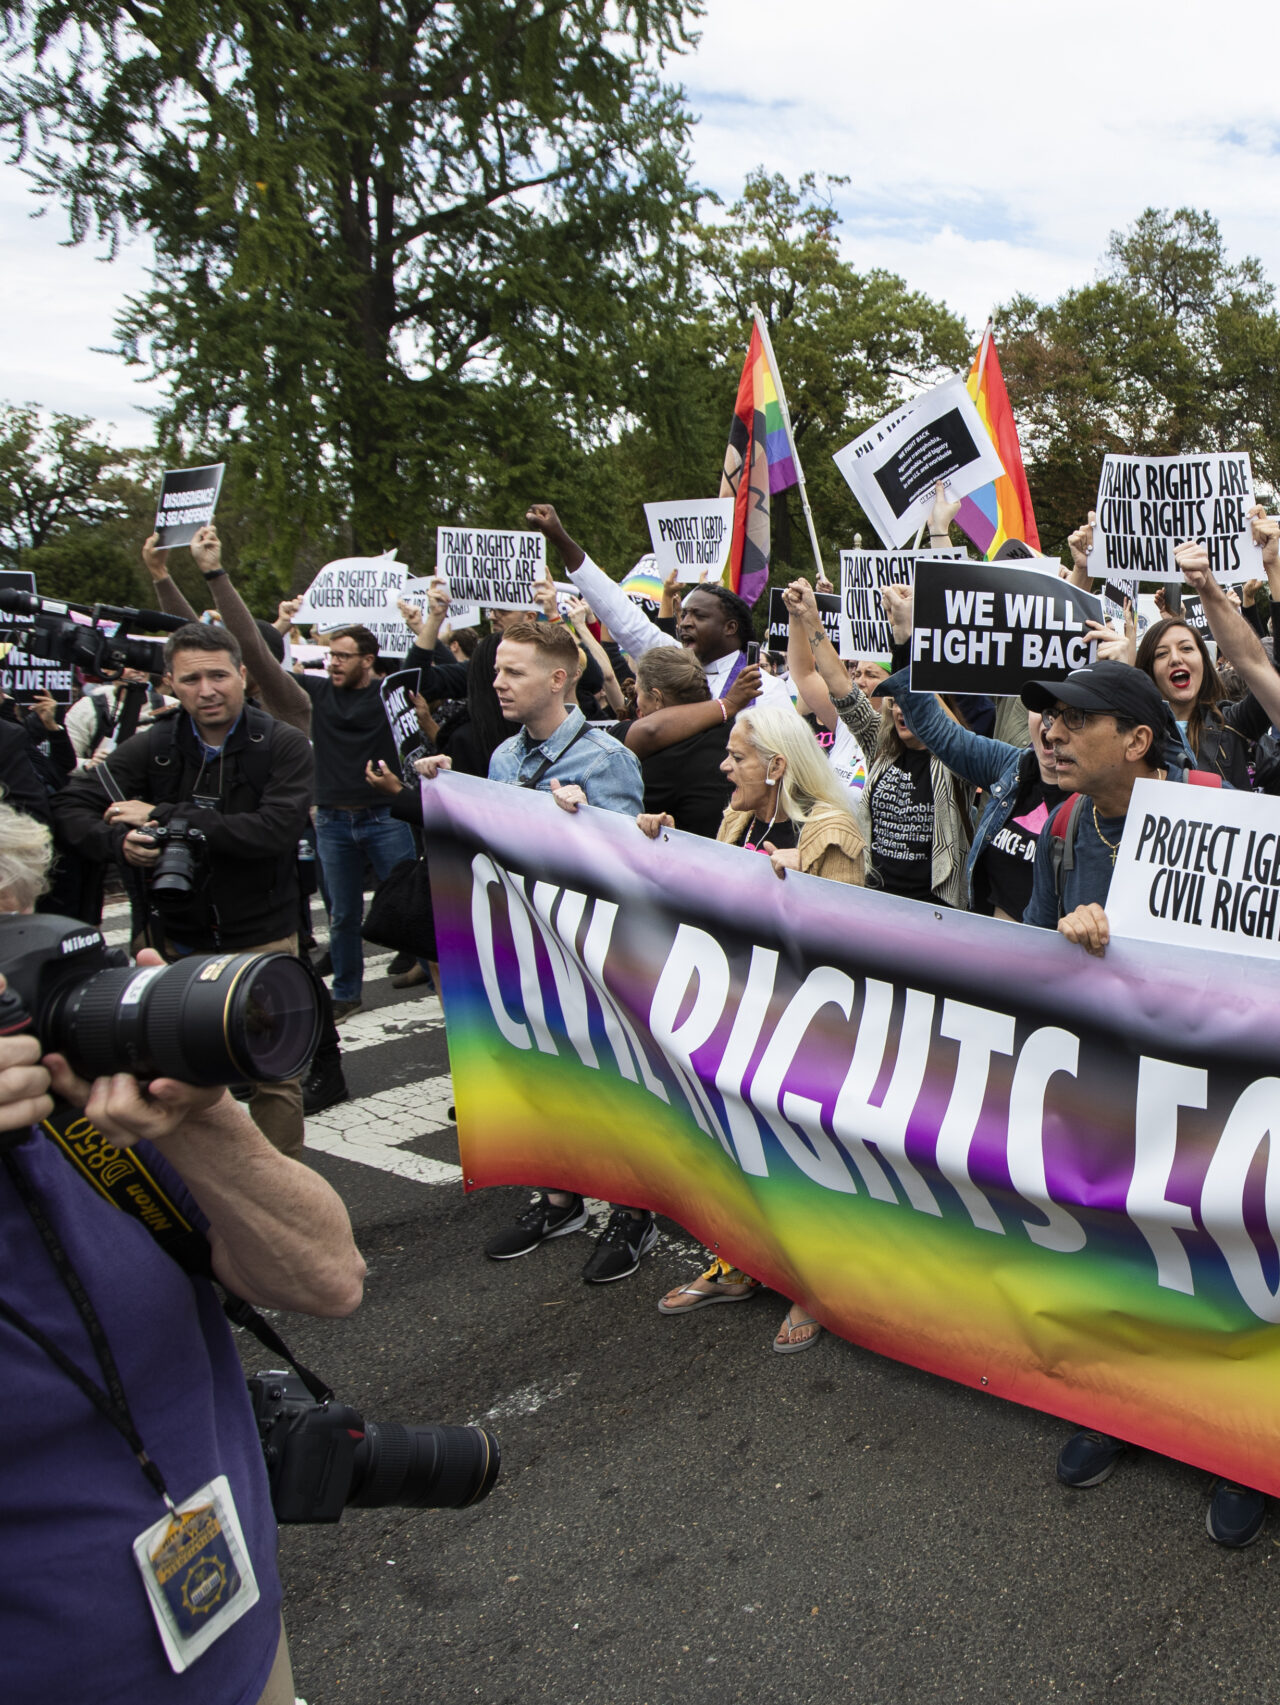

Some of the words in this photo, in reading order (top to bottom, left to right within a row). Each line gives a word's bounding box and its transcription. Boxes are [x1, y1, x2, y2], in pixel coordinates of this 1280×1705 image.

[1100, 461, 1142, 500] TRANS
[1145, 461, 1213, 500] RIGHTS
[1219, 460, 1249, 497] ARE
[658, 517, 698, 541] PROTECT
[700, 516, 727, 541] LGBTQ+
[1100, 498, 1136, 535] CIVIL
[1140, 500, 1207, 537] RIGHTS
[1213, 497, 1246, 535] ARE
[442, 532, 473, 555] TRANS
[476, 534, 515, 558] RIGHTS
[519, 536, 541, 559] ARE
[675, 541, 694, 564] CIVIL
[696, 540, 721, 564] RIGHTS
[1105, 535, 1169, 572] HUMAN
[1174, 534, 1241, 572] HTS
[337, 570, 378, 589] RIGHTS
[381, 571, 402, 590] ARE
[445, 555, 469, 578] CIVIL
[472, 557, 512, 580] RIGHTS
[515, 559, 536, 582] ARE
[844, 556, 874, 588] TRANS
[876, 556, 925, 588] RIGHT
[309, 589, 344, 609] QUEER
[346, 589, 388, 608] RIGHTS
[449, 578, 491, 601] HUMAN
[493, 581, 533, 604] RIGHTS
[846, 589, 871, 620] CIVIL
[944, 589, 995, 627] WE
[1004, 593, 1083, 632] WILL
[913, 628, 1013, 667] FIGHT
[15, 670, 44, 690] LIVE
[45, 670, 72, 690] FREE
[1135, 813, 1241, 877] PROTECT
[1149, 868, 1206, 926] CIVIL
[61, 931, 101, 954] Nikon
[471, 852, 672, 1106] CIVIL
[648, 923, 1087, 1254] RIGHTS
[65, 1117, 135, 1187] D850
[126, 1184, 172, 1231] Nikon
